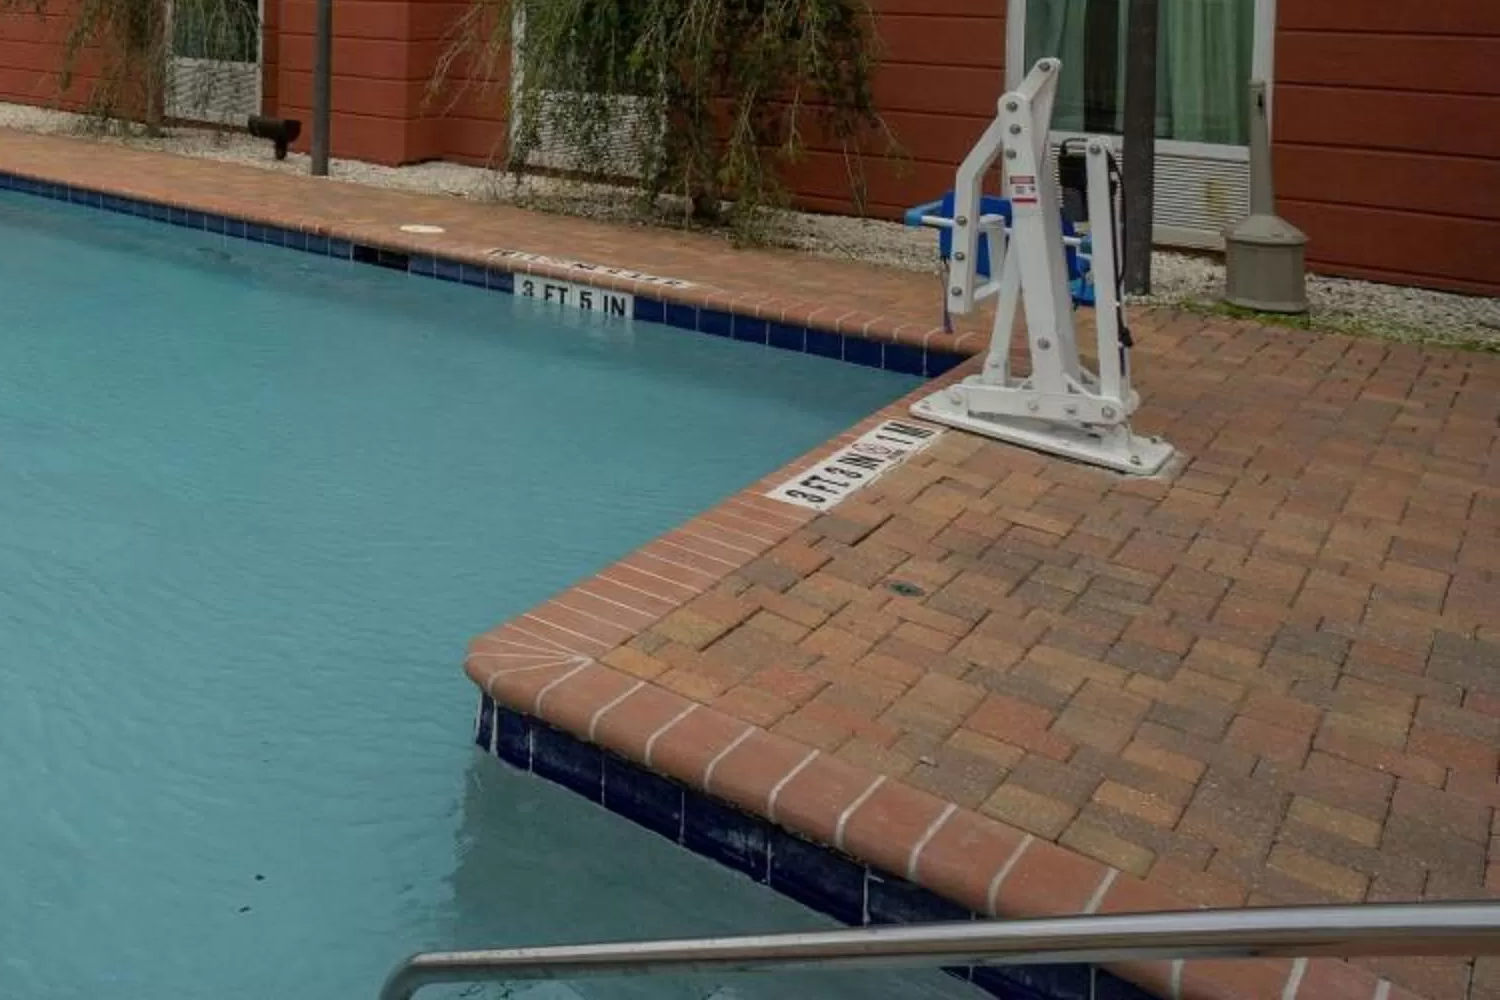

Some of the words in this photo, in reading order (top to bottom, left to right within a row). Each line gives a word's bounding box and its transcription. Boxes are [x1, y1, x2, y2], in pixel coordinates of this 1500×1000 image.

[522, 279, 535, 297] 3
[543, 285, 569, 305] FT
[579, 291, 594, 310] 5
[603, 294, 626, 317] IN
[836, 452, 884, 471] IN
